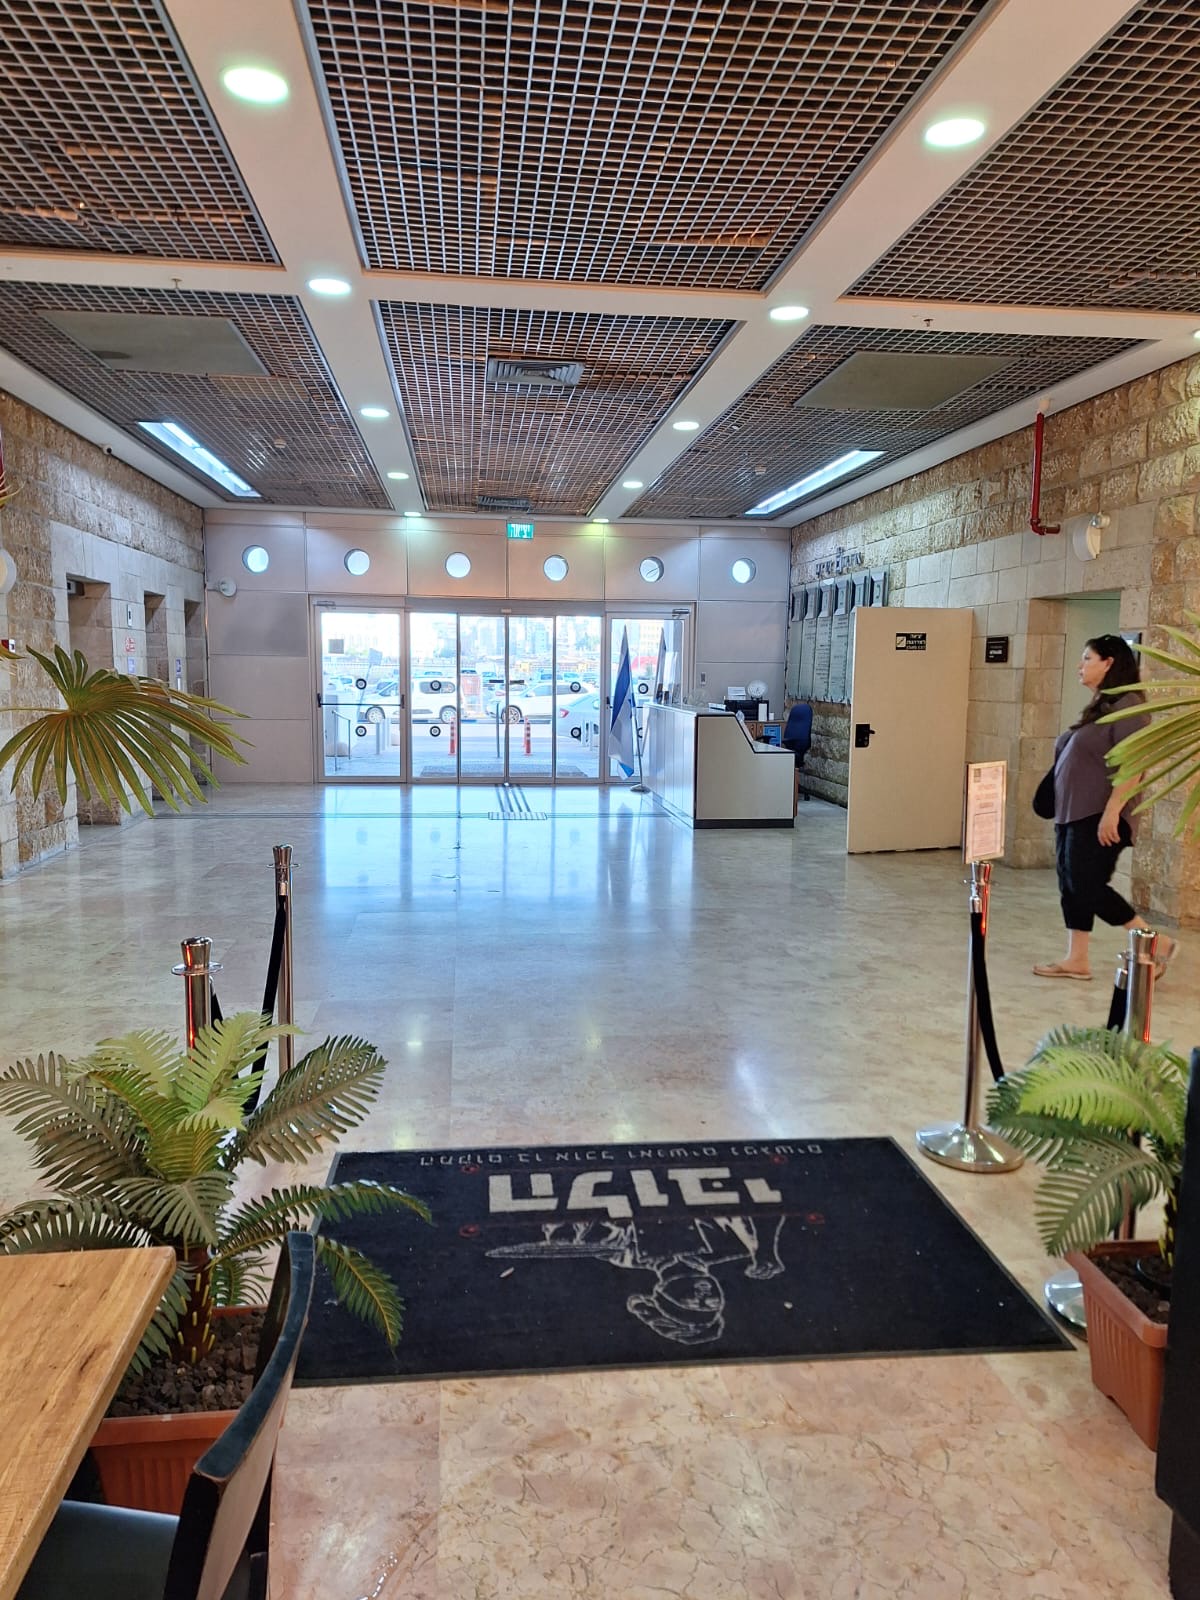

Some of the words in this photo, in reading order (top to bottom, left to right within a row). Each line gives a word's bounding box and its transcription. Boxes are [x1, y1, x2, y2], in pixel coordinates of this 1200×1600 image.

[511, 523, 531, 539] יציאה
[420, 1153, 502, 1166] המקום
[518, 1153, 542, 1162] בו
[555, 1150, 614, 1161] אוכל
[628, 1147, 717, 1159] ואנשים
[731, 1144, 822, 1156] נפגשים
[489, 1167, 782, 1219] הלובי
